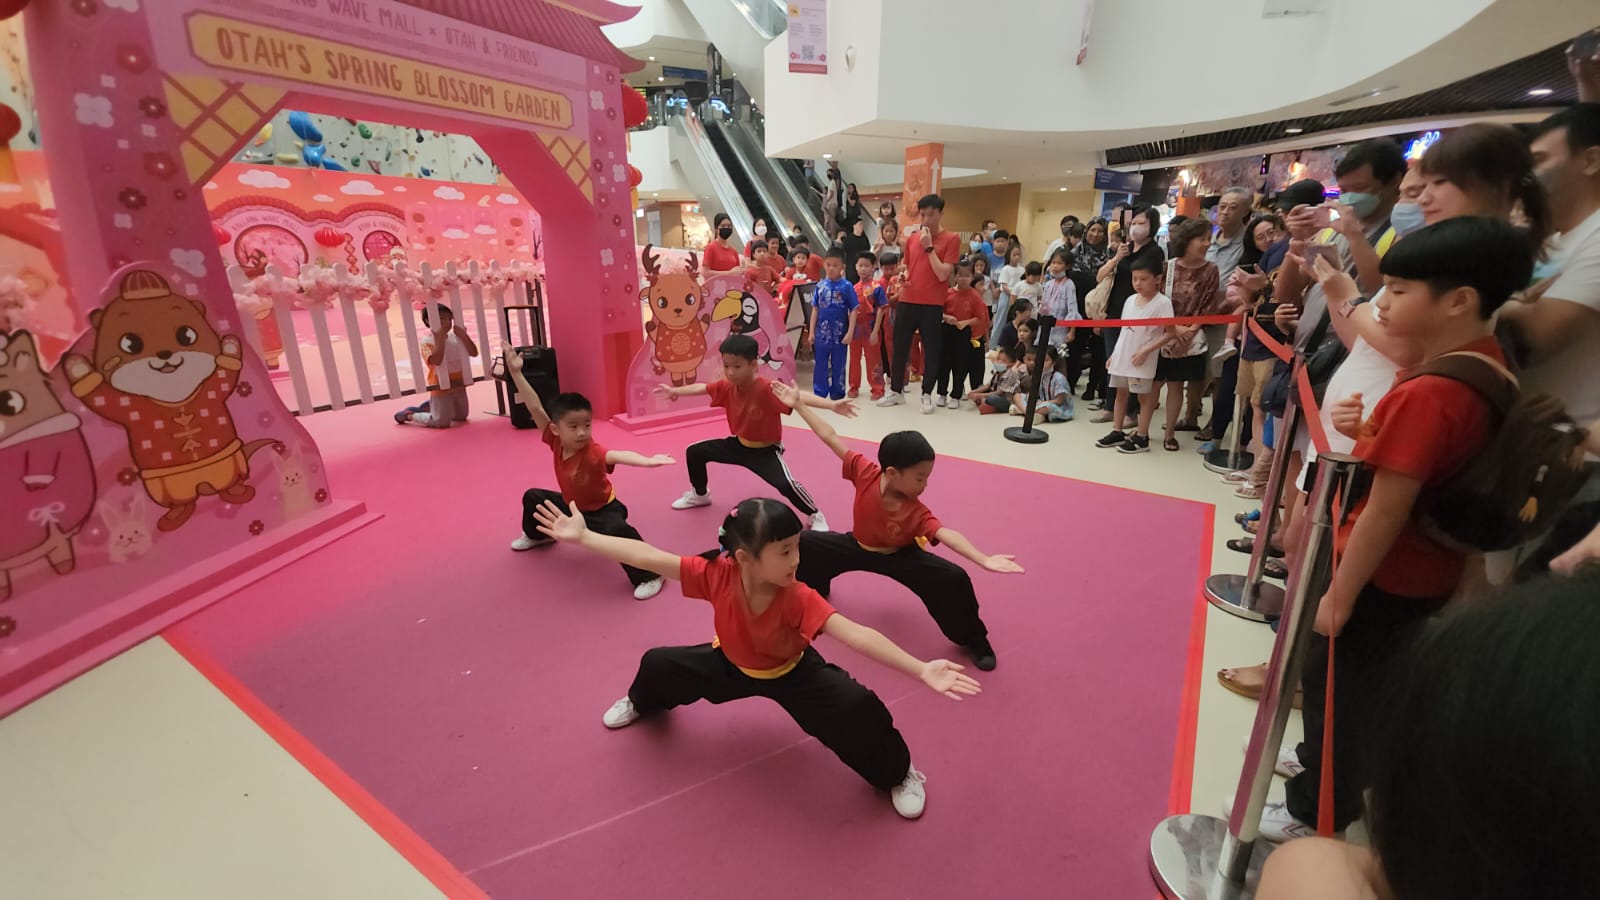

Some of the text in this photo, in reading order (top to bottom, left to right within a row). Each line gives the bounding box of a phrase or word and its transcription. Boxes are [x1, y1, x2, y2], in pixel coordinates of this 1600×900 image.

[327, 0, 372, 24] WAVE
[379, 8, 422, 36] MALL
[445, 27, 476, 50] OTAH
[482, 37, 490, 54] &
[496, 41, 538, 67] FRIENDS
[216, 27, 561, 122] OTAH'S SPRING BLOSSOM GARDEN
